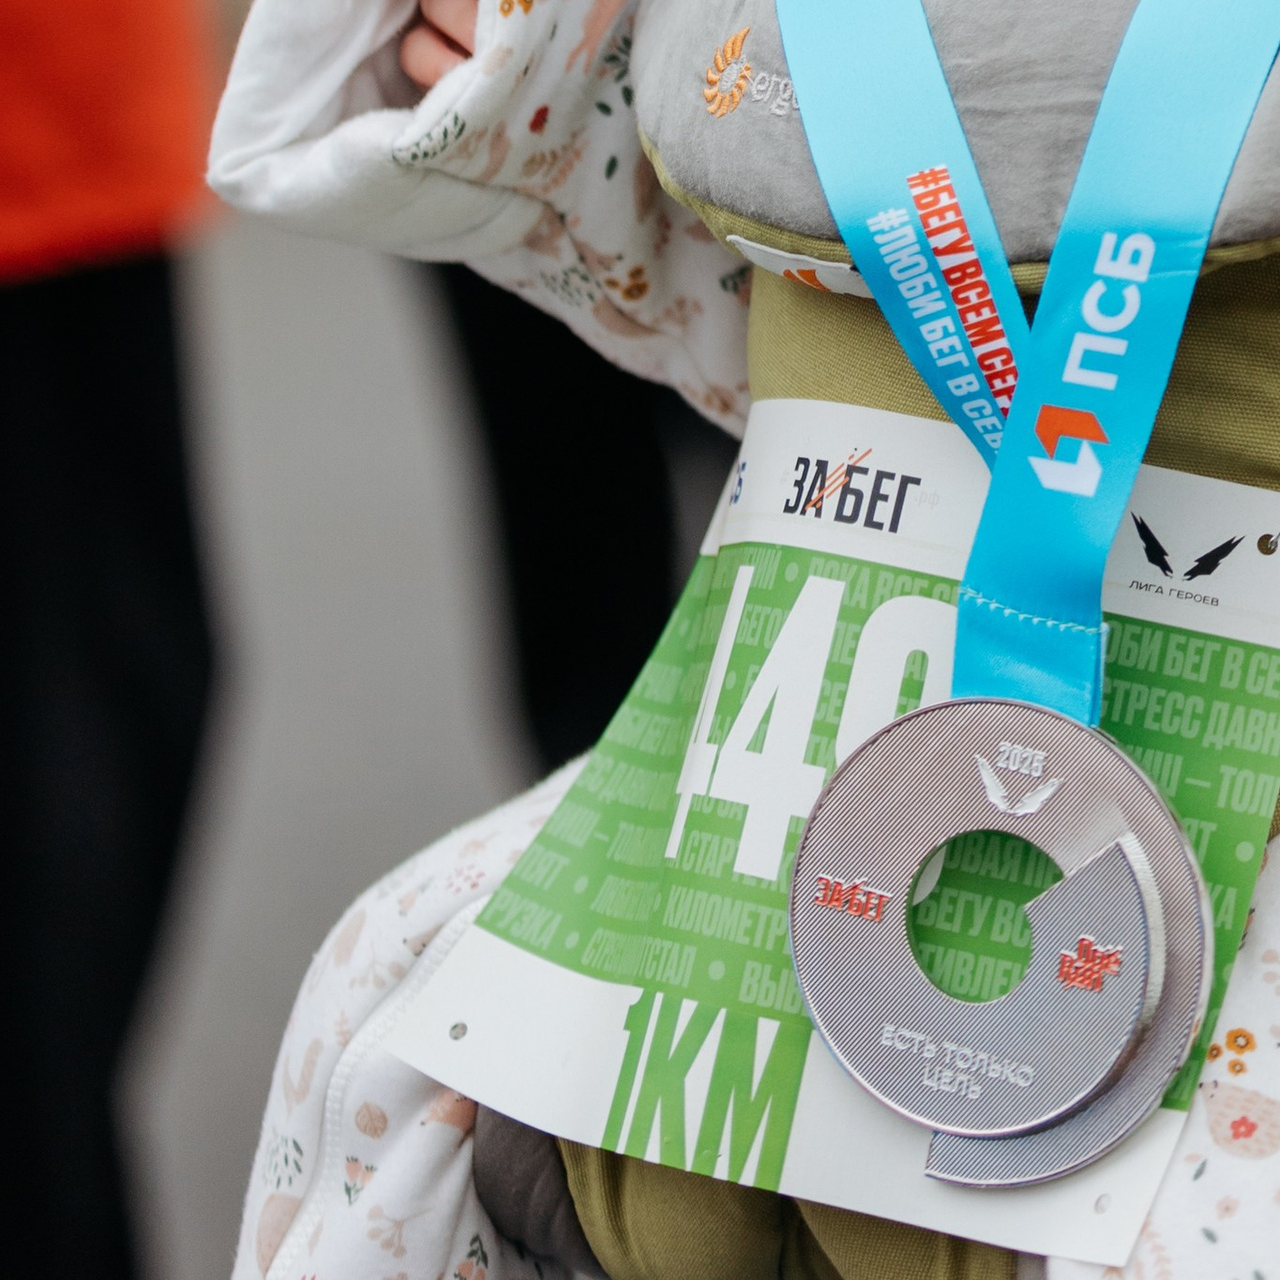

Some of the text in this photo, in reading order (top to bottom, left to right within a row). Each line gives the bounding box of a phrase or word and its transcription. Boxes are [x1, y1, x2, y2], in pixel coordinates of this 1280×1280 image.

[865, 208, 1003, 454] #ЛЮБИ БЕГ В СЕБ
[1062, 232, 1156, 391] ПСБ
[1129, 580, 1220, 607] ЛИГА ГЕРОЕВ
[1163, 633, 1222, 684] БЕГ
[1220, 645, 1245, 690] В
[996, 742, 1046, 778] 2025
[881, 1024, 1035, 1087] ЕСТЬ ТОЛЬКО
[922, 1064, 981, 1100] ЦЕЛЬ
